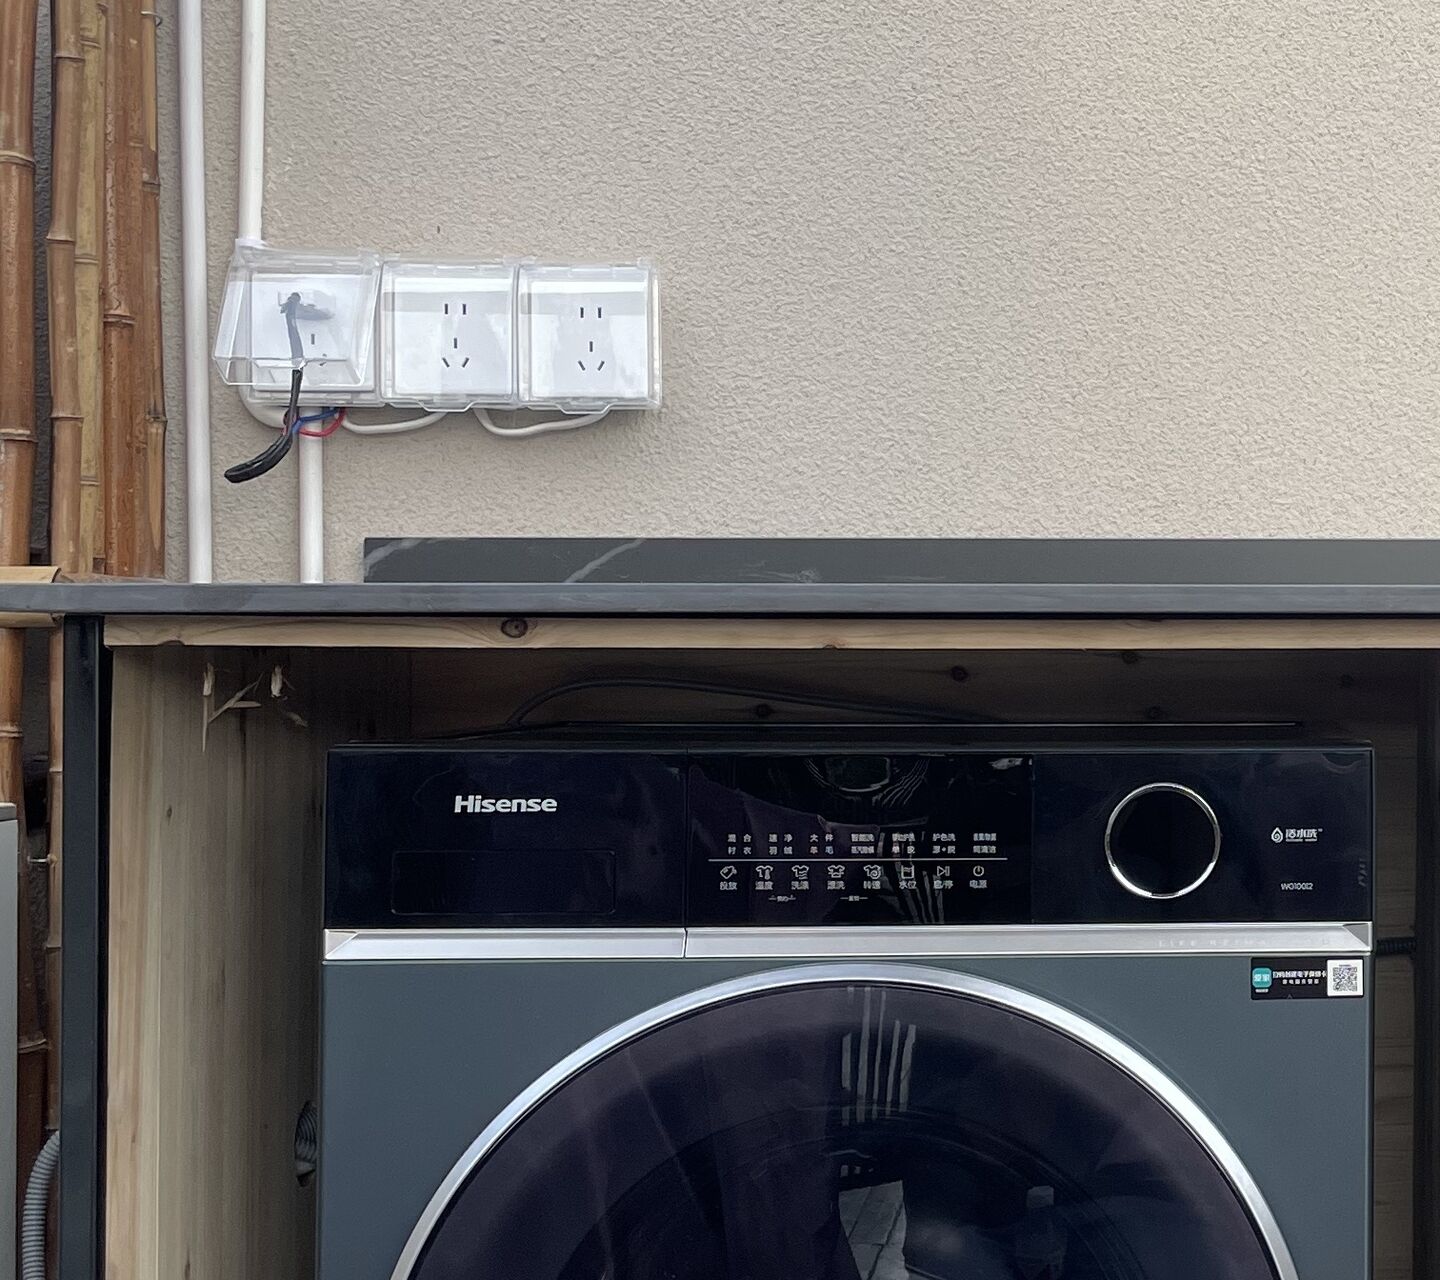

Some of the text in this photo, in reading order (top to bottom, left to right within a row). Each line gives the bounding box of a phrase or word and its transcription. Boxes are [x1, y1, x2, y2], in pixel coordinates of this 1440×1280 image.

[454, 795, 558, 813] Hisense
[810, 833, 834, 842] 大件
[932, 833, 956, 842] 护色洗
[899, 880, 917, 890] 水位
[969, 880, 988, 890] 电源
